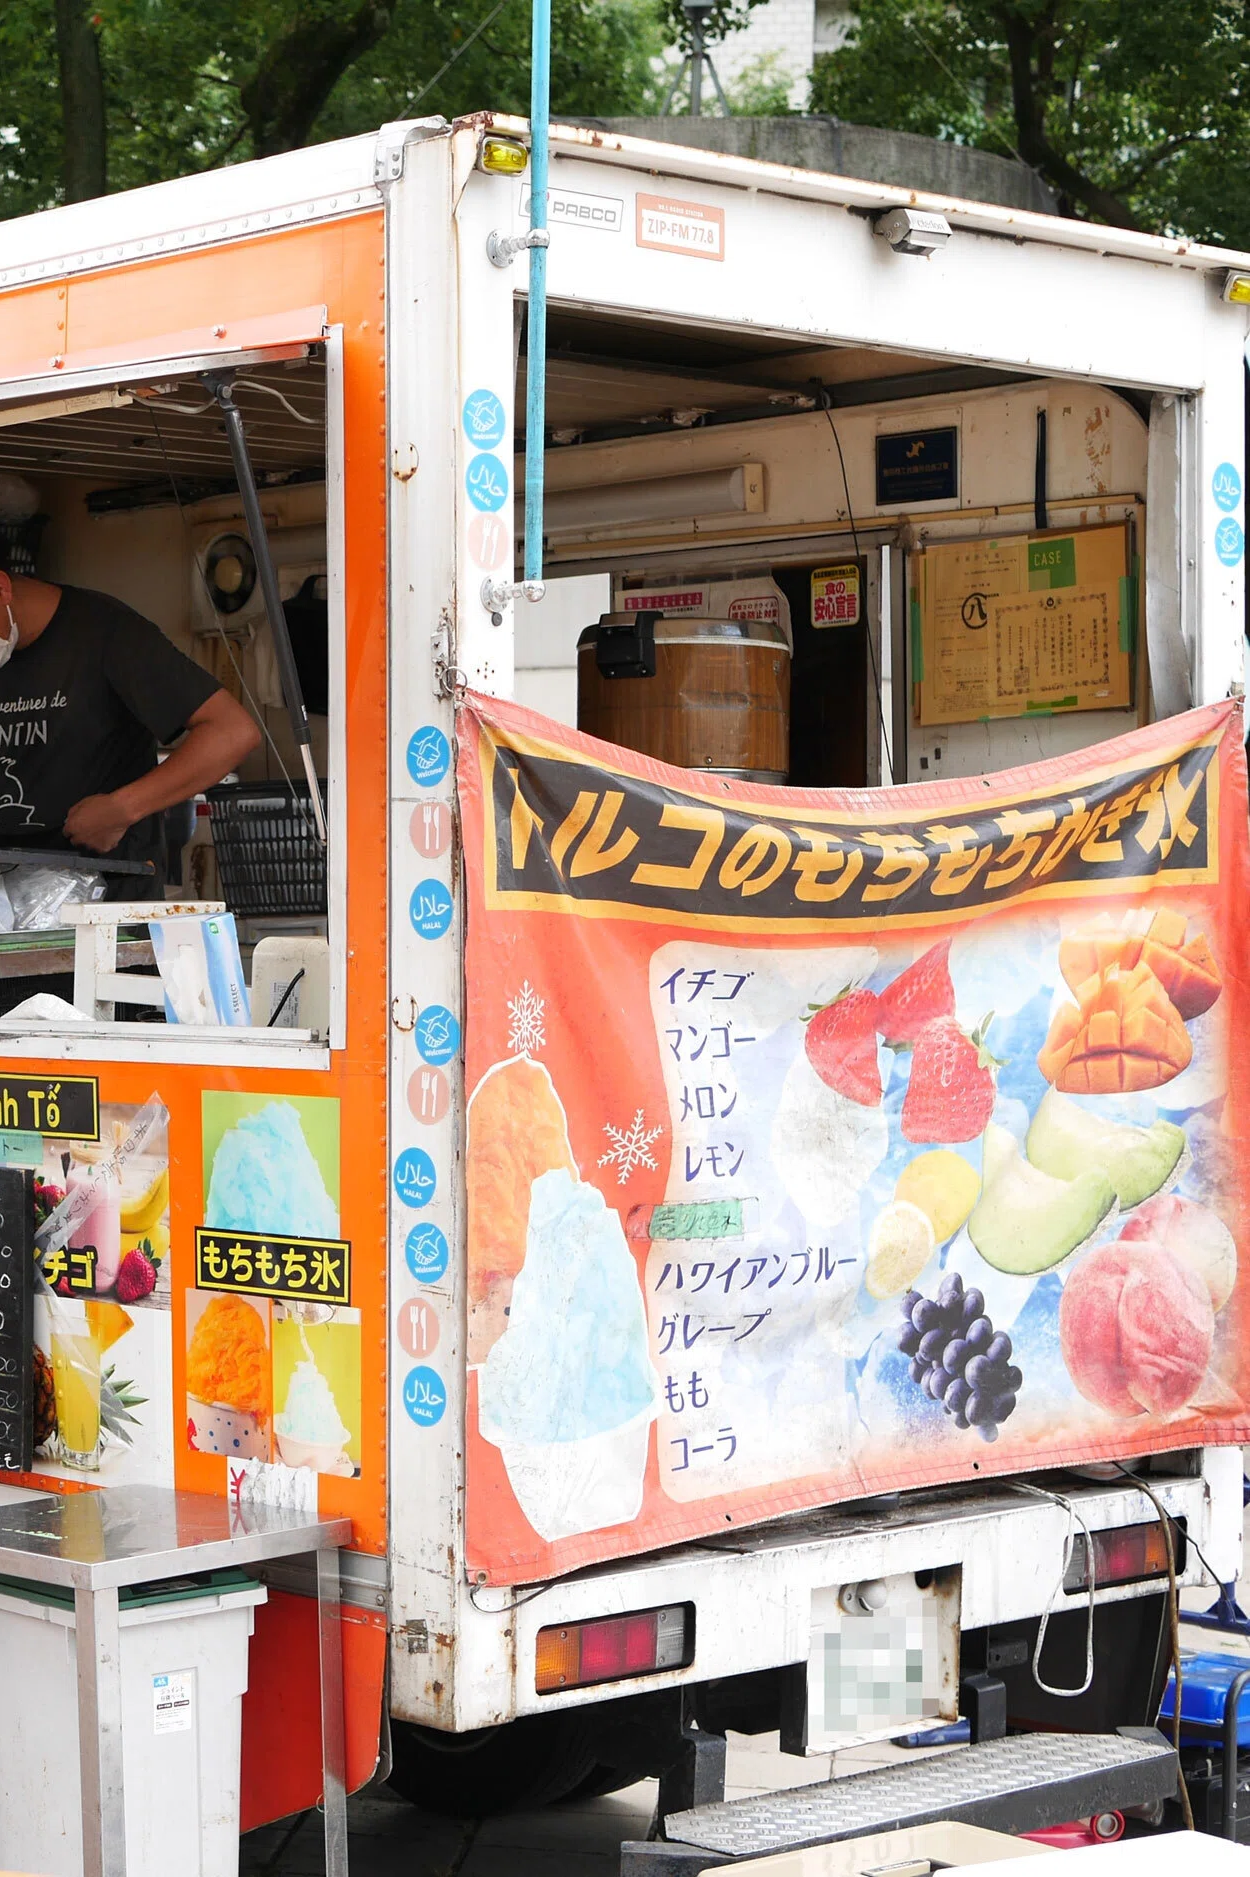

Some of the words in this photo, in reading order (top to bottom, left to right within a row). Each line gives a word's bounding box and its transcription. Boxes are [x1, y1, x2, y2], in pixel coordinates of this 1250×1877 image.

[553, 201, 616, 223] PABCO
[692, 226, 714, 244] 77.8
[1034, 549, 1062, 566] CASE
[51, 690, 67, 708] de
[416, 766, 444, 780] Welcome!
[412, 893, 450, 921] حلال
[422, 921, 442, 930] HALAL
[660, 967, 755, 1005] イチゴ
[665, 1020, 756, 1062] マンゴー
[27, 1082, 62, 1128] Tố
[679, 1083, 737, 1122] メロン
[396, 1160, 434, 1187] حلال
[685, 1142, 745, 1182] レモン
[403, 1188, 423, 1199] HALAL
[34, 1246, 96, 1289] チゴ
[203, 1239, 341, 1292] もちもち氷
[655, 1246, 857, 1294] ハワイアンブルー
[657, 1308, 772, 1355] グレープ
[406, 1379, 444, 1405] حلال
[664, 1371, 709, 1414] もも
[413, 1406, 434, 1418] HALAL
[670, 1427, 737, 1472] コーラ
